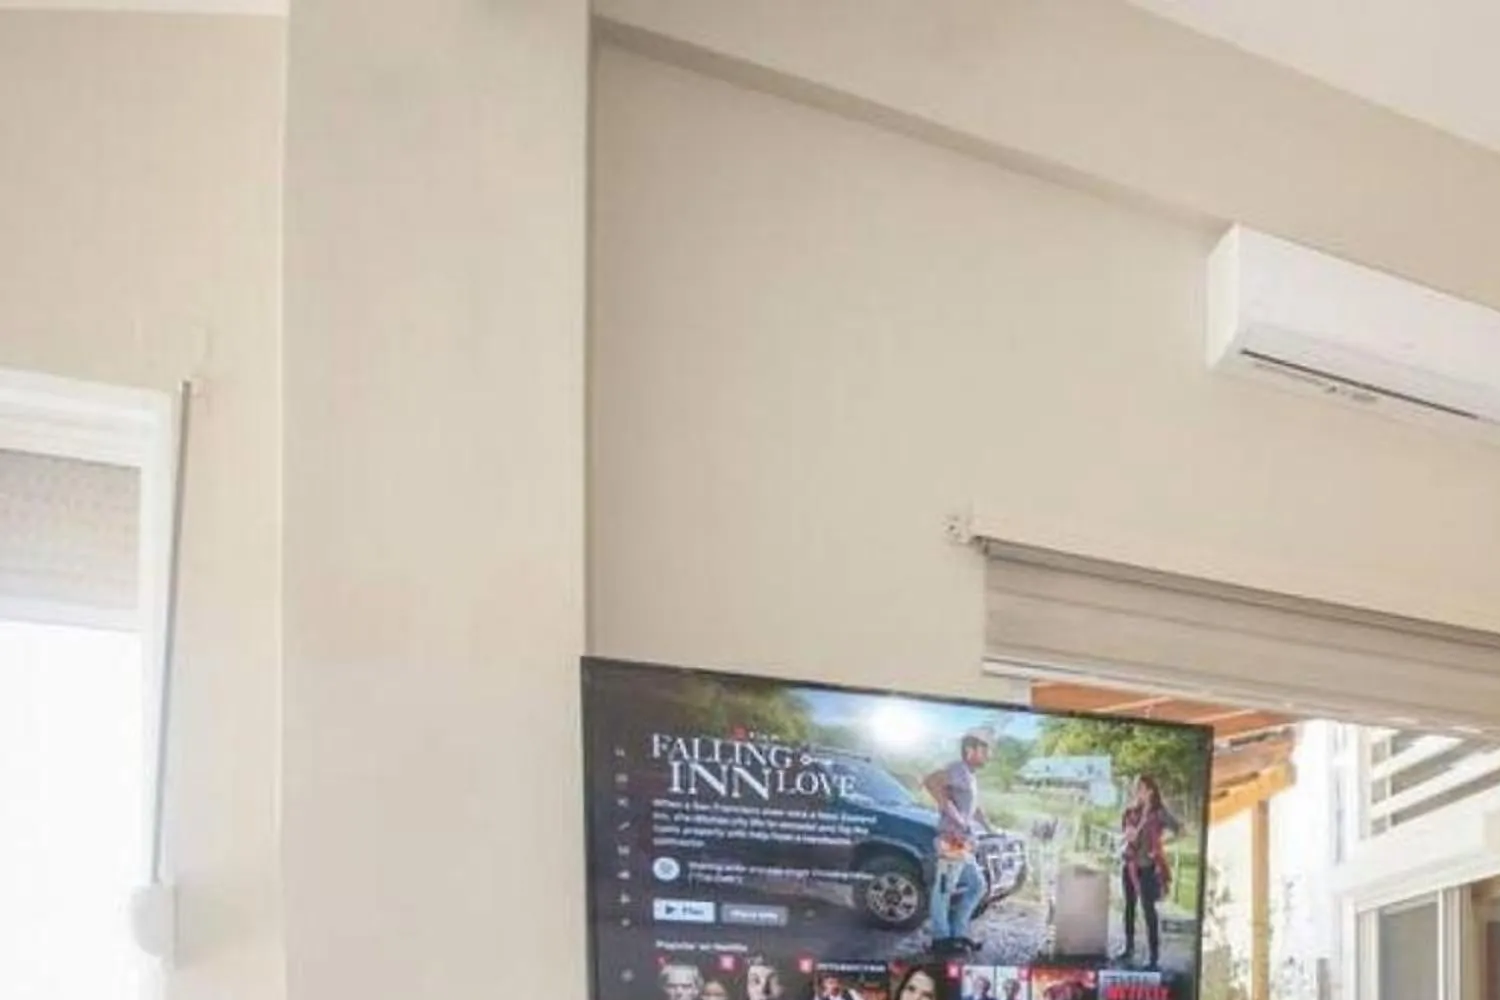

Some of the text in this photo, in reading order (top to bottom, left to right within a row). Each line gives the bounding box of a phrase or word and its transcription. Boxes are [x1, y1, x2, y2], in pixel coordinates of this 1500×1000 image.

[652, 733, 793, 769] FALLING
[668, 760, 857, 800] INN LOVE
